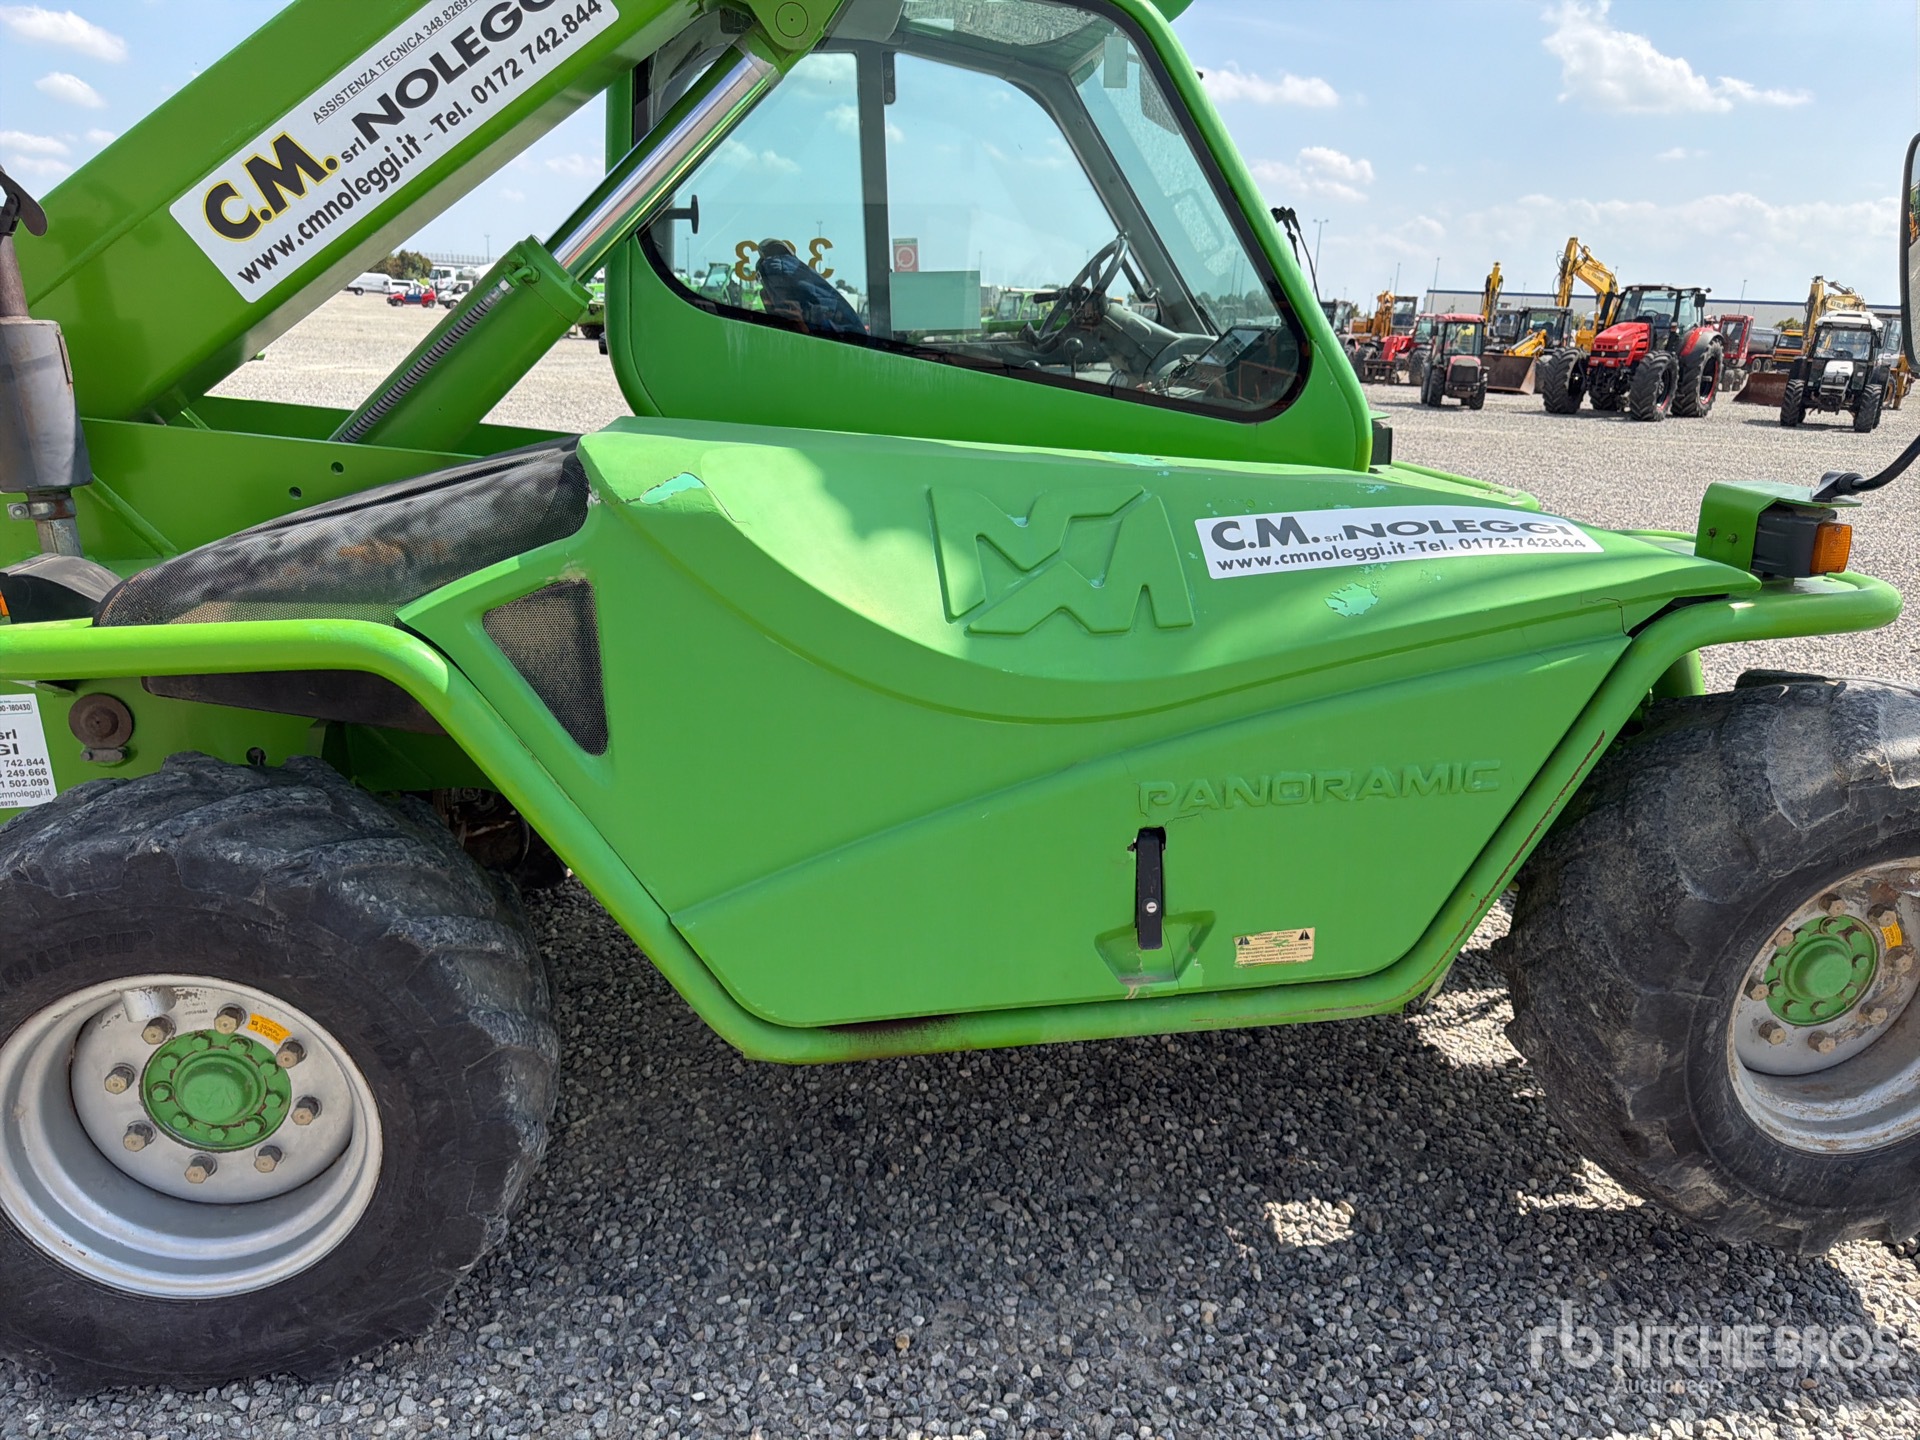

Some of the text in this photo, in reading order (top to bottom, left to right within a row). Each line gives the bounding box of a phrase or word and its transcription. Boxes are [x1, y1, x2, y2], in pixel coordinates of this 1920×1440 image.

[312, 0, 473, 123] ASSISTENZA TECNICA 348.8269
[237, 133, 422, 284] www.cmnoleggi.it
[429, 101, 473, 134] Tel.
[471, 58, 524, 104] 0172
[520, 0, 602, 65] 742.844
[203, 131, 340, 242] C.M.
[341, 136, 367, 164] srl
[1211, 516, 1574, 551] C.M. srl NOLEGGI
[1459, 537, 1586, 550] 0172.742844
[4, 758, 45, 767] 742.844
[7, 768, 47, 777] 249.666
[9, 778, 49, 788] 502.099
[1138, 760, 1501, 814] PANORAMIC
